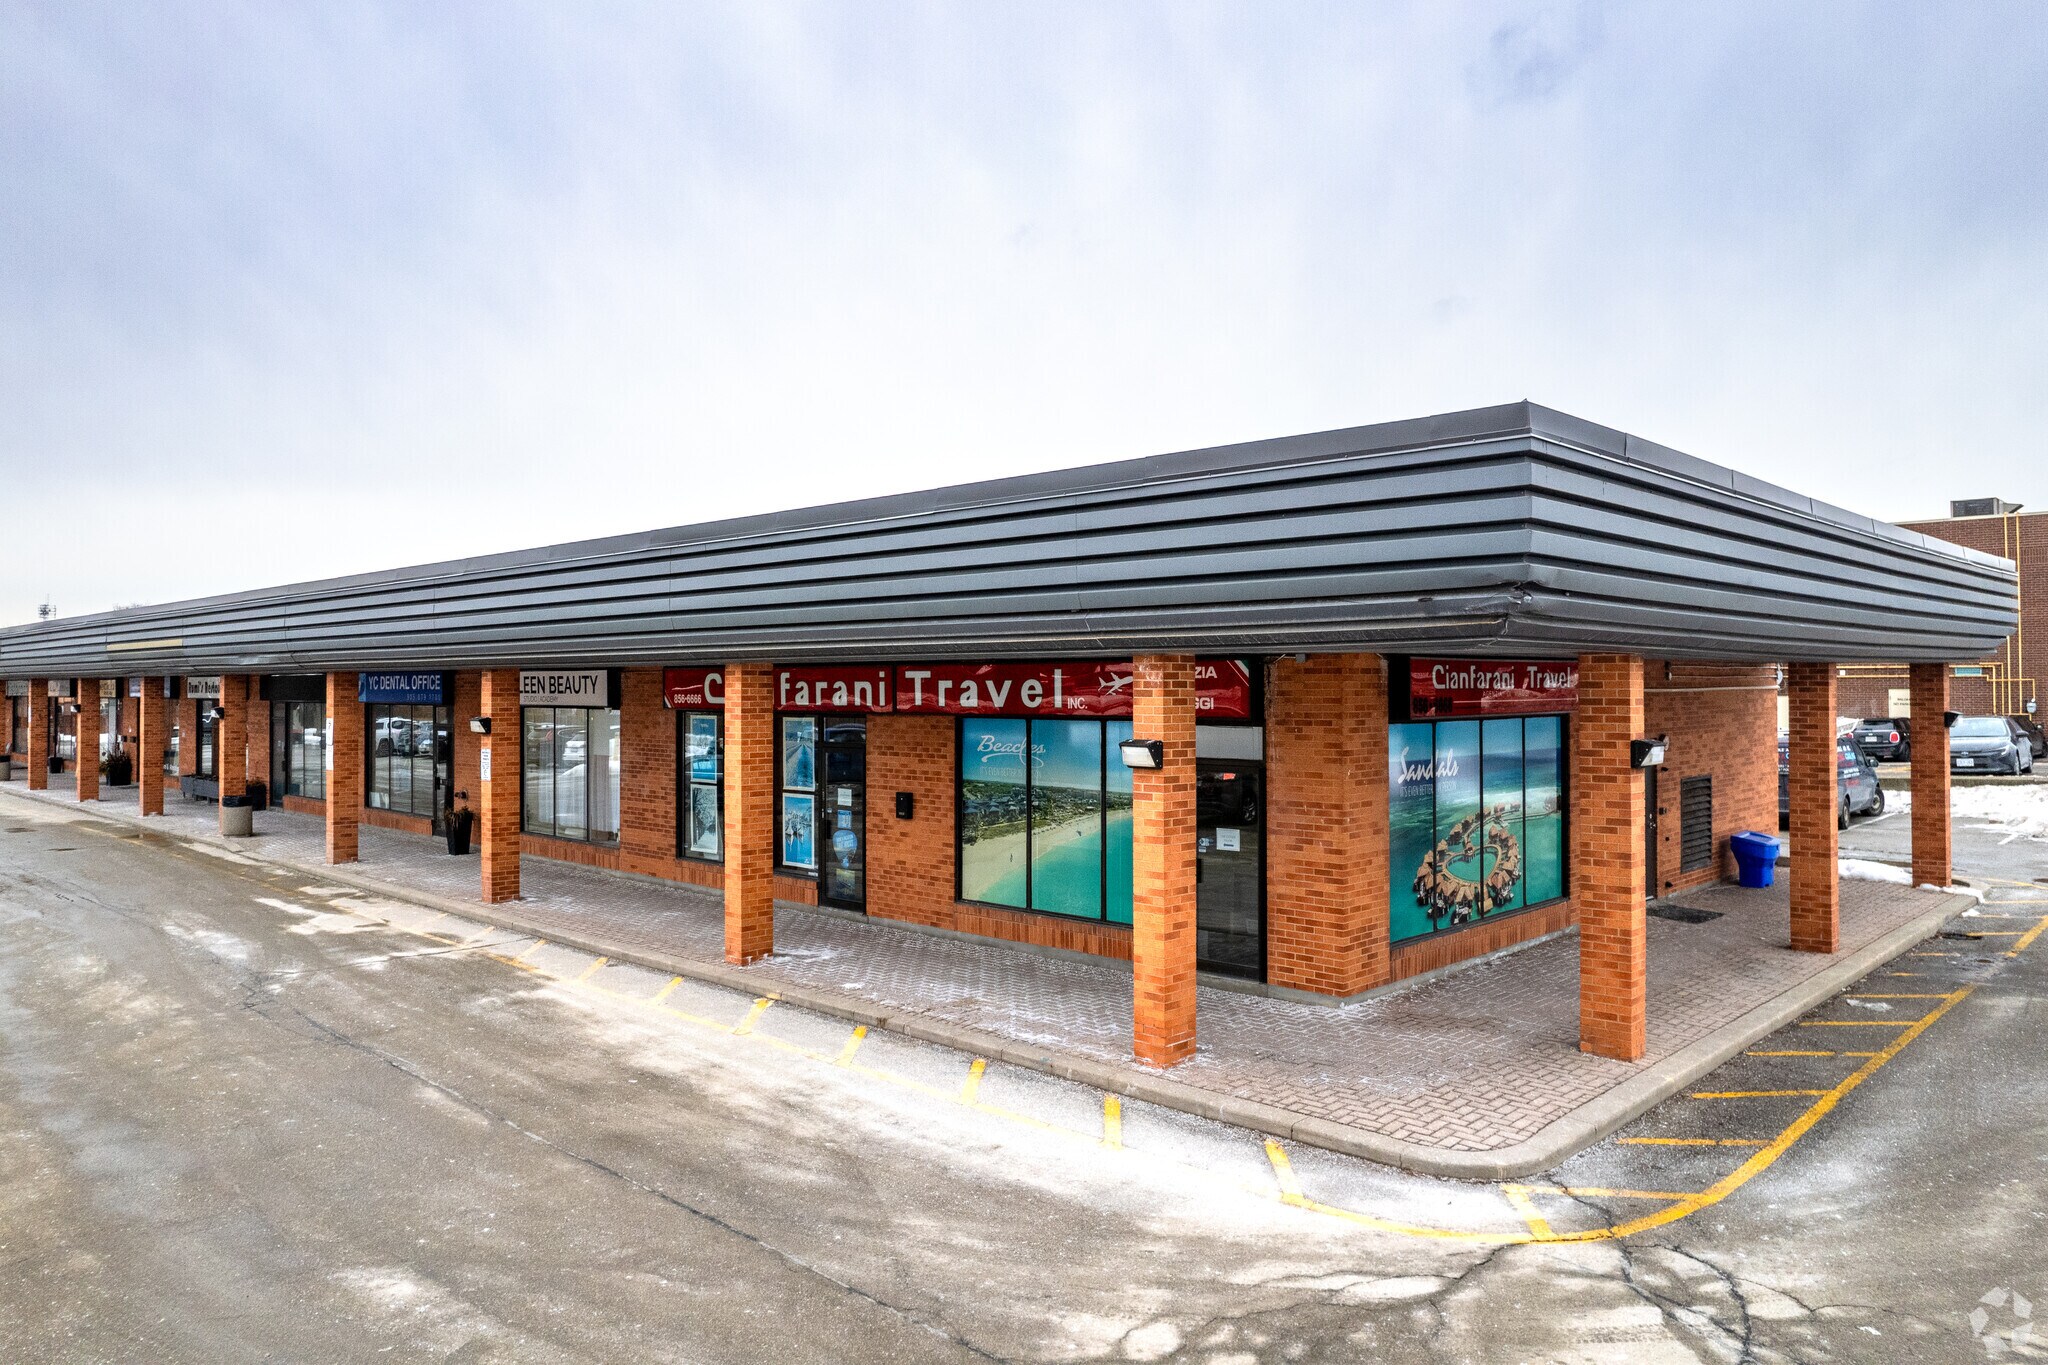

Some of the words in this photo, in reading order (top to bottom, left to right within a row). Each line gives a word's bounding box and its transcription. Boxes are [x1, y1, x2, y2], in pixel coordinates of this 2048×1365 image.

[368, 676, 379, 690] YC
[381, 675, 410, 690] DENTAL
[411, 675, 441, 690] OFFICE
[549, 675, 598, 694] BEAUTY
[1431, 664, 1515, 690] Cianfarani
[1526, 666, 1572, 689] Travel
[904, 668, 1063, 708] Travel
[1067, 697, 1088, 709] INC.
[673, 693, 702, 704] 856-6666
